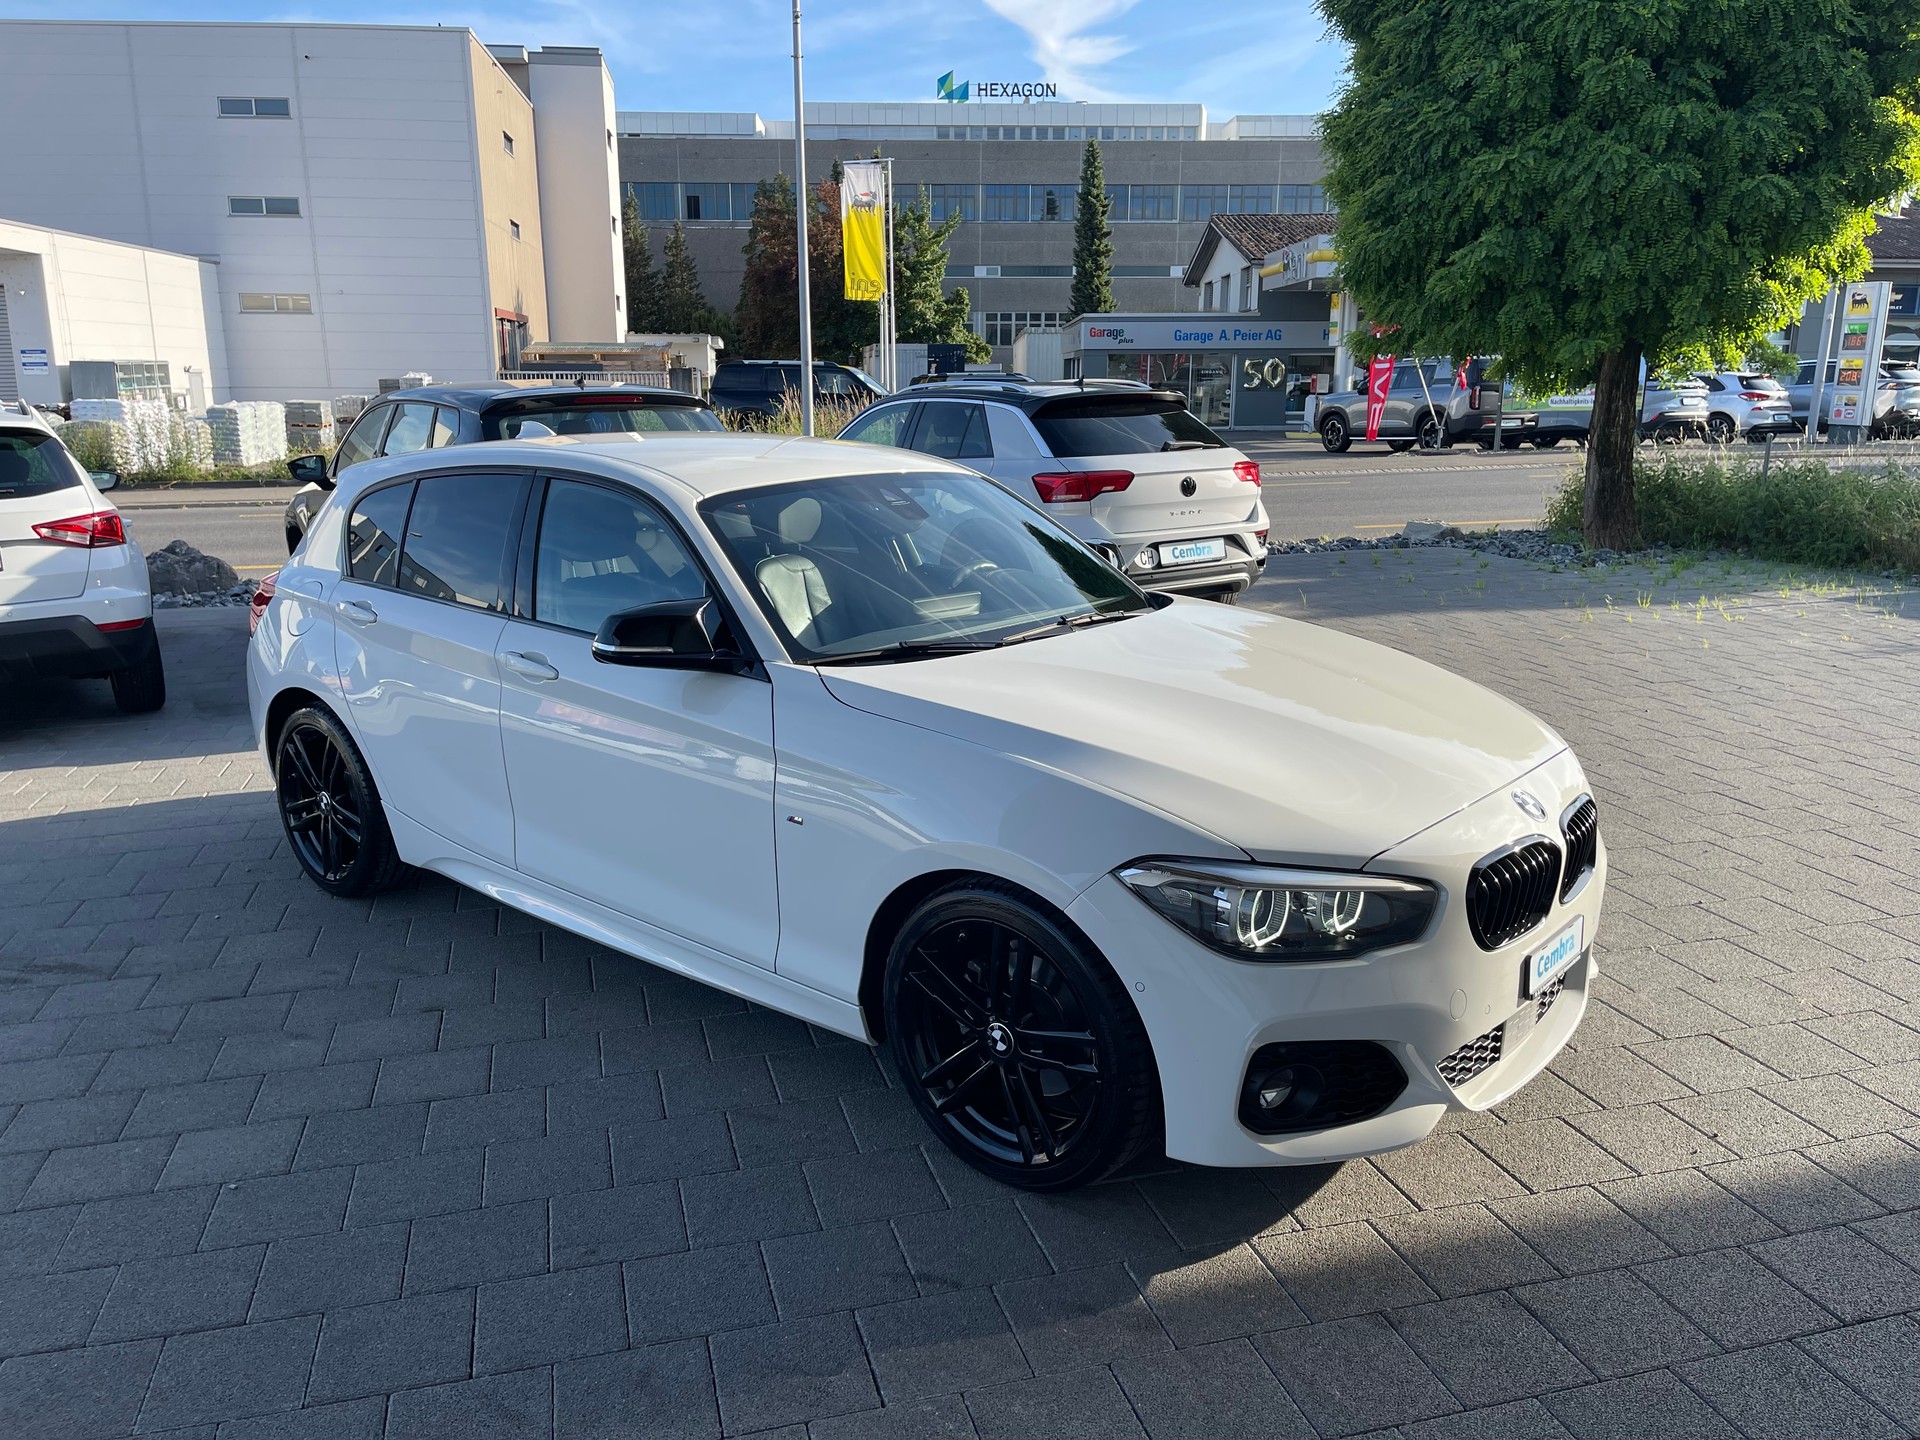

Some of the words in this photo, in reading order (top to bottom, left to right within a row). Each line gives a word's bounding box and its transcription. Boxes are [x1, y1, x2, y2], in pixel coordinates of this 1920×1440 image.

[977, 82, 1057, 97] HEXAGON
[1089, 327, 1125, 340] Garage
[1174, 329, 1214, 343] Garage
[1219, 329, 1230, 341] A.
[1233, 329, 1263, 341] Peier
[1265, 329, 1282, 341] AG
[1243, 357, 1286, 388] 50
[1139, 550, 1155, 566] CH
[1172, 543, 1213, 559] Cembra
[1537, 934, 1575, 979] Cembra
